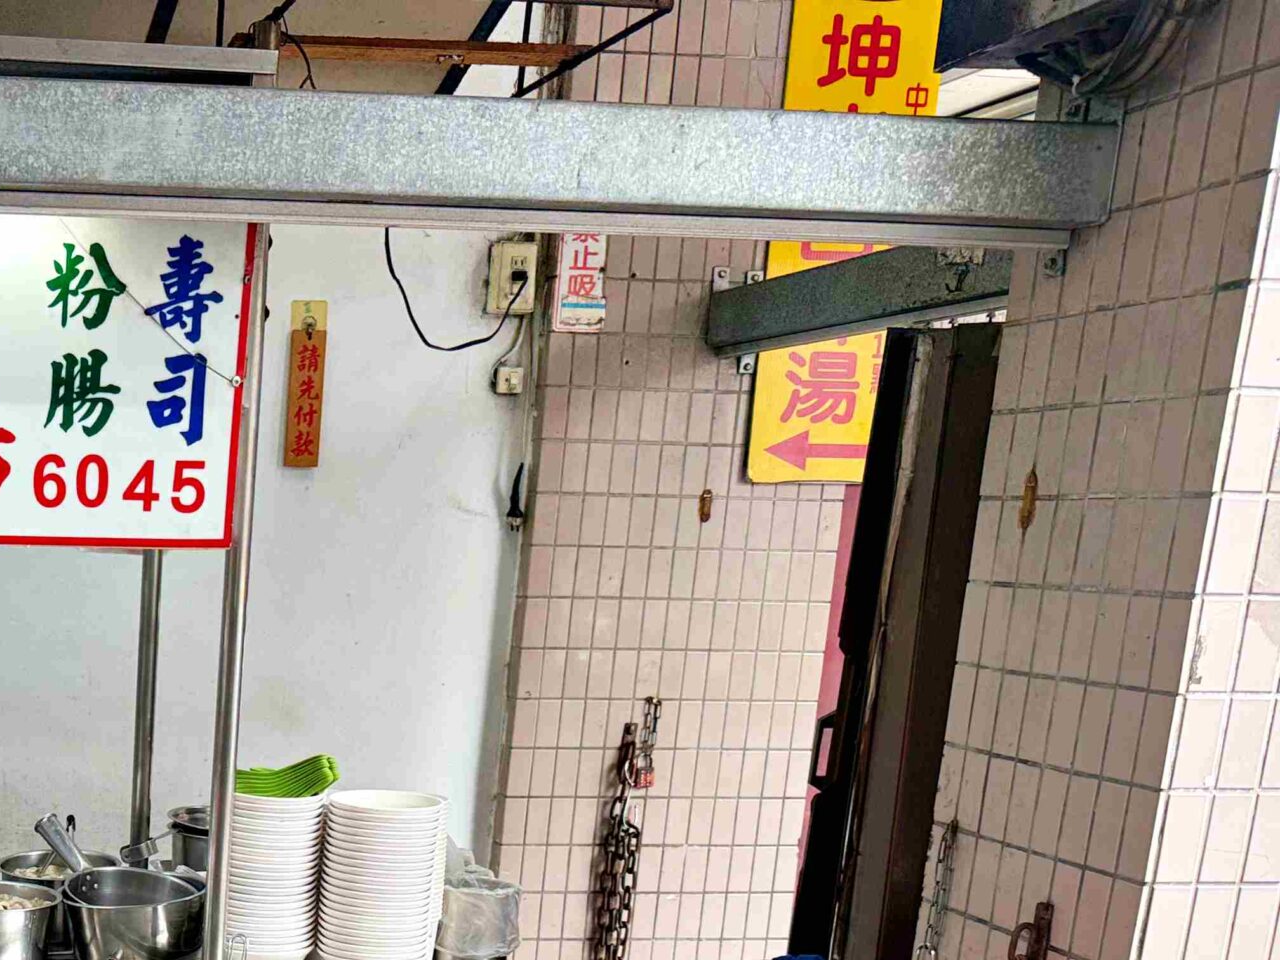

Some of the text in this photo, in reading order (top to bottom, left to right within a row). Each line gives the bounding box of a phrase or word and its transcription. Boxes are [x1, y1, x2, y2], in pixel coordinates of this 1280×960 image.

[44, 242, 127, 437] 粉腸
[144, 235, 223, 446] 壽司
[290, 344, 320, 457] 請先付款
[33, 454, 206, 513] 60 45
